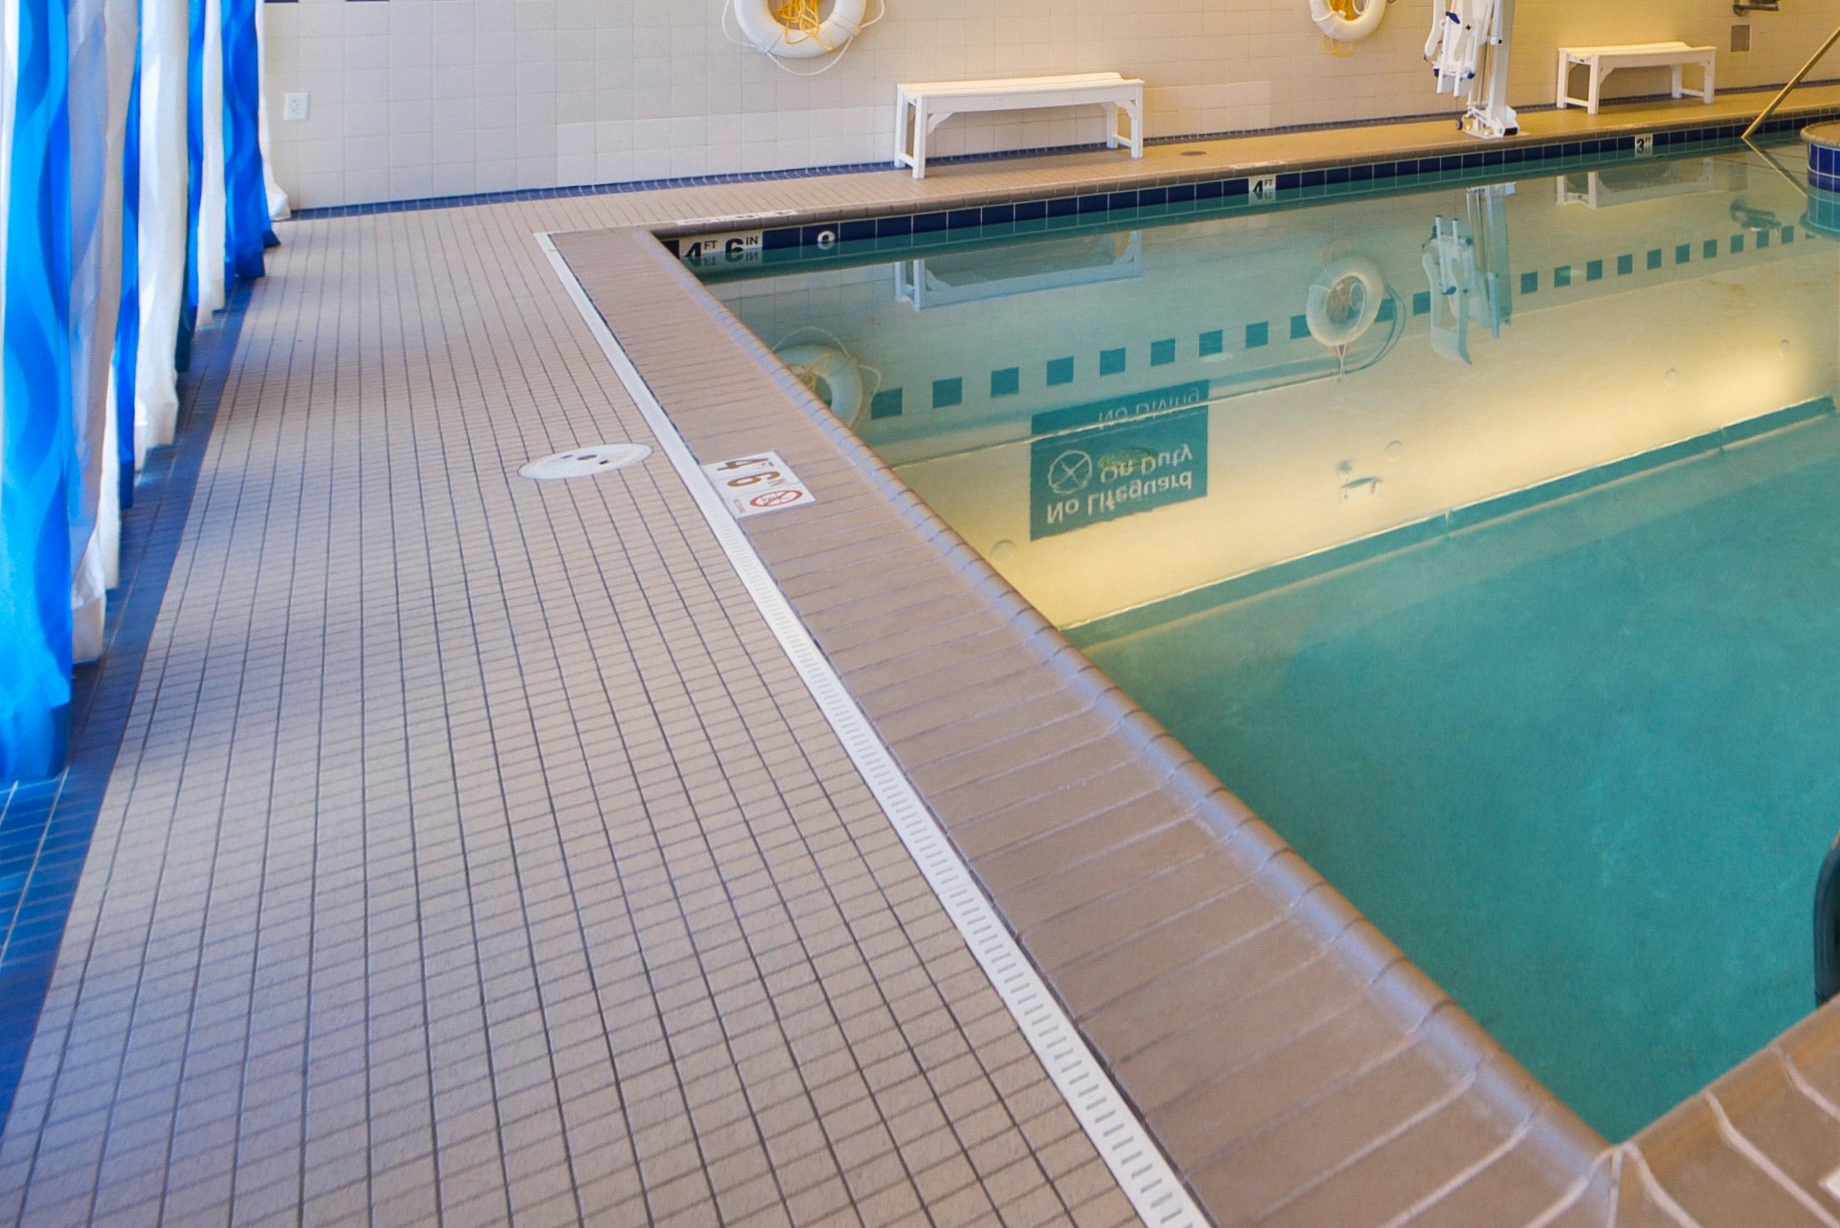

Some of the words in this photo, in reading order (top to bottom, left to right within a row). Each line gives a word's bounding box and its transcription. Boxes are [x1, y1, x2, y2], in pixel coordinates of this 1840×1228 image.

[704, 239, 718, 250] FT
[746, 236, 759, 245] IN
[717, 458, 769, 471] 4
[727, 471, 781, 487] 6
